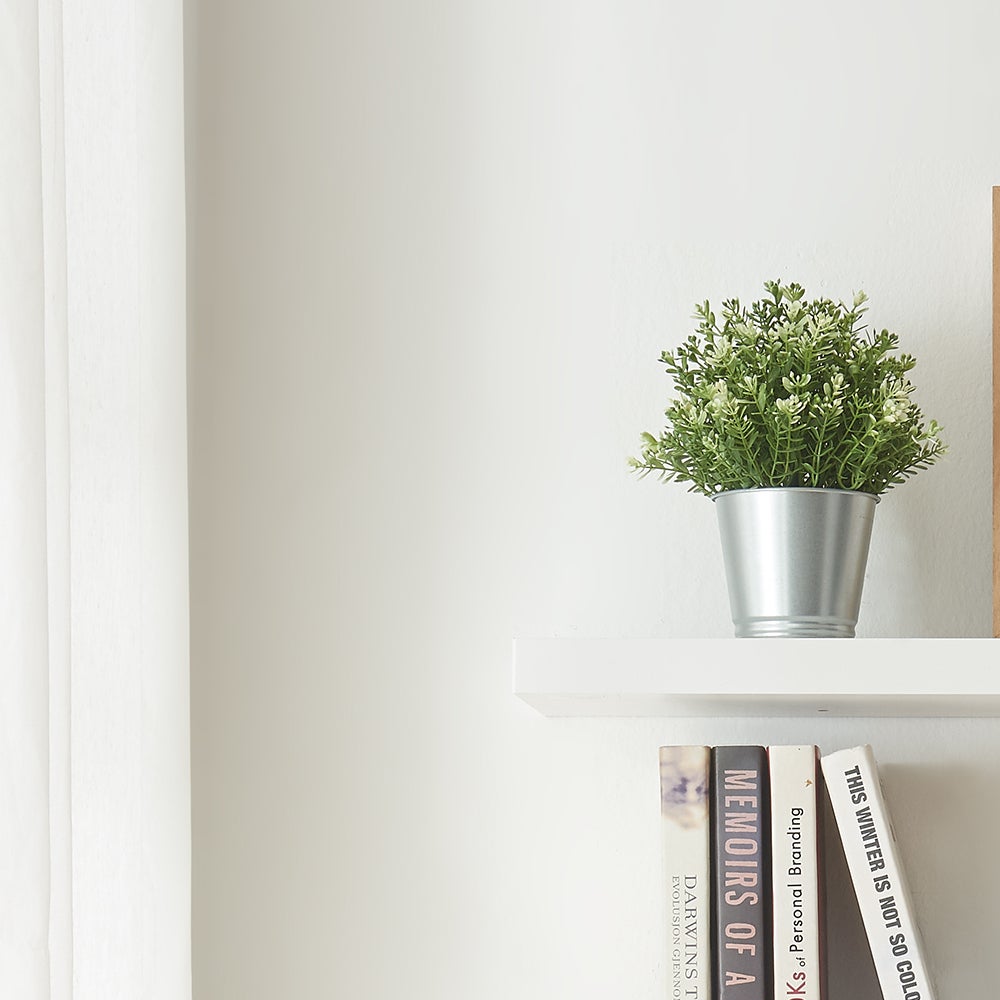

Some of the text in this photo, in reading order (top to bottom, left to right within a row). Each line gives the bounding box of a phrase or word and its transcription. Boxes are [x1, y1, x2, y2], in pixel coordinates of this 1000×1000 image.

[844, 765, 868, 805] THIS
[723, 769, 759, 906] MEMOIRS
[787, 807, 804, 876] Branding
[855, 806, 886, 873] WINTER
[873, 874, 892, 894] IS
[672, 876, 681, 945] EVOLUSJON
[684, 875, 698, 980] DARWINS
[787, 884, 804, 953] Personal
[878, 895, 902, 929] NOT
[725, 921, 757, 957] OF
[889, 933, 909, 958] SO
[725, 972, 756, 986] A
[796, 957, 806, 967] of
